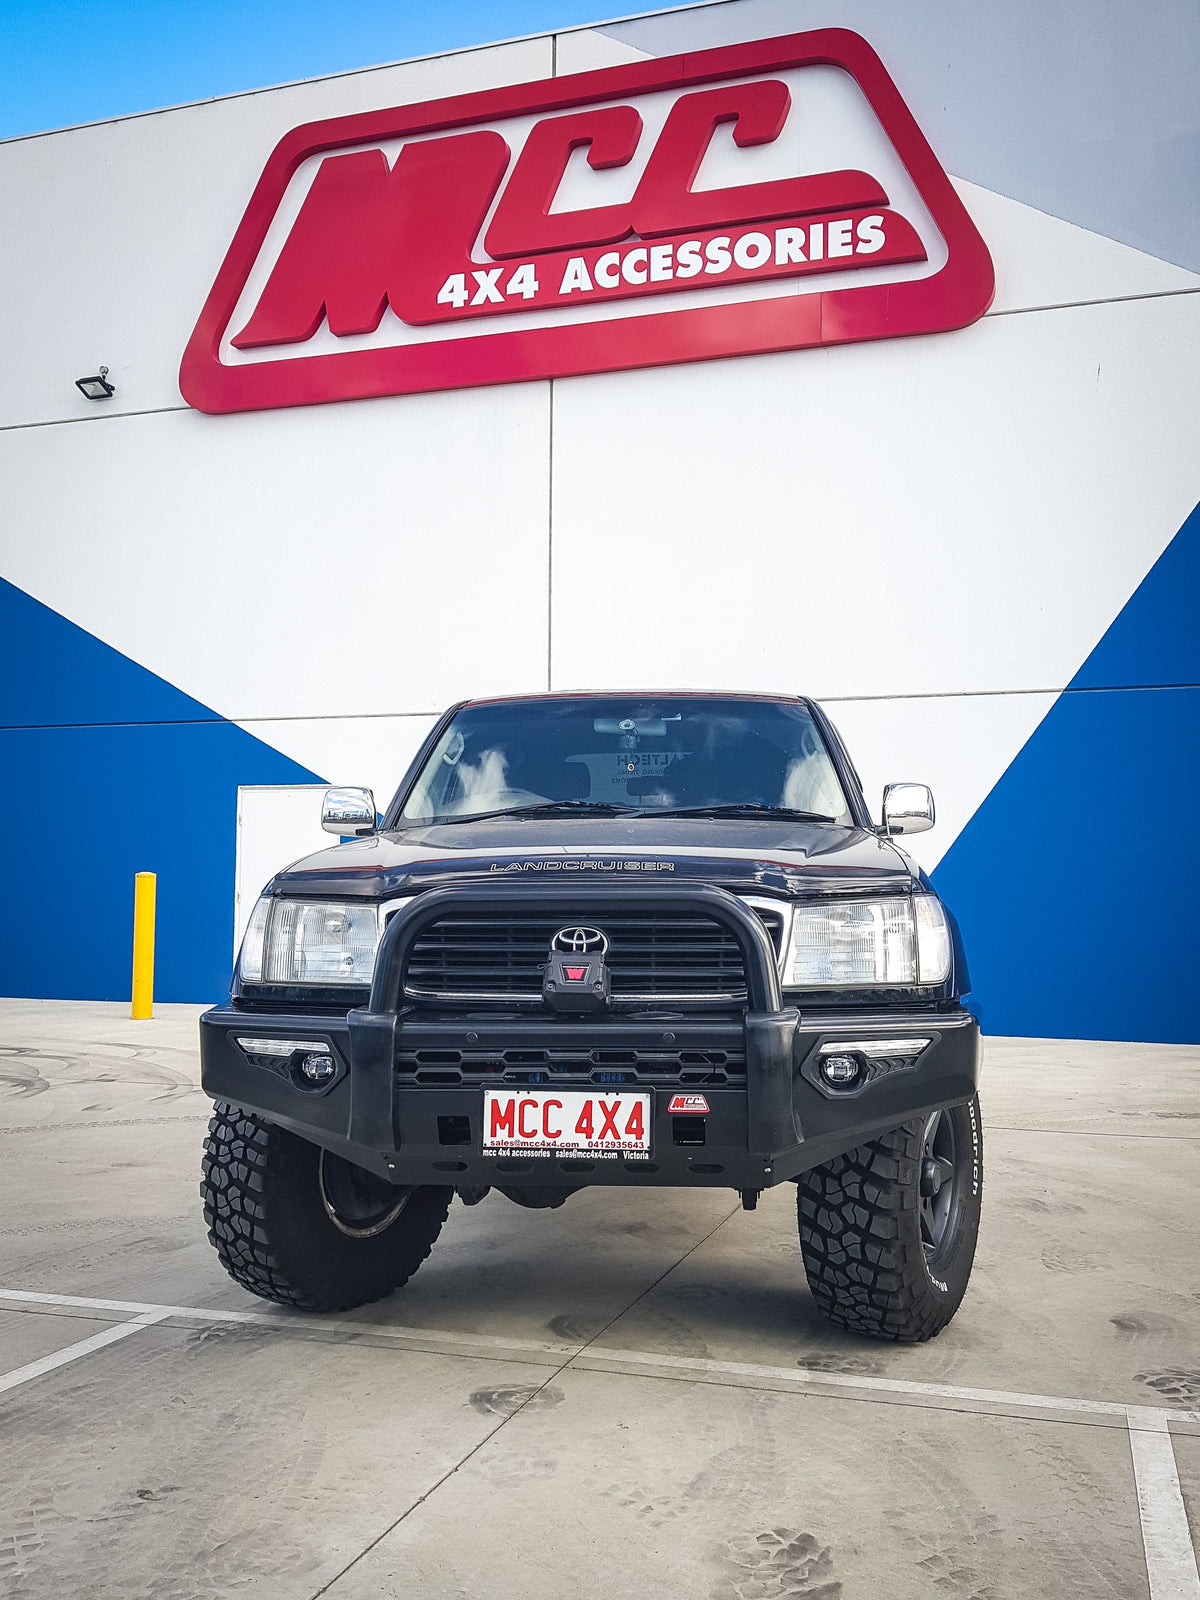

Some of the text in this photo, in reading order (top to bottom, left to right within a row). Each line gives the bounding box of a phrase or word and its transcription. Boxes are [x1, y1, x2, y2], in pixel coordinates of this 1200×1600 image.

[231, 79, 891, 349] MCC
[437, 215, 887, 308] 4X4 ACCESSORIES
[489, 861, 675, 872] LANDCRUISER
[490, 1099, 645, 1140] MCC 4X4
[482, 1148, 649, 1160] mcc 4x4 accessories sales@mcc4x4.com Victoria
[490, 1139, 645, 1149] sales@mcc4x4.com 0412935643
